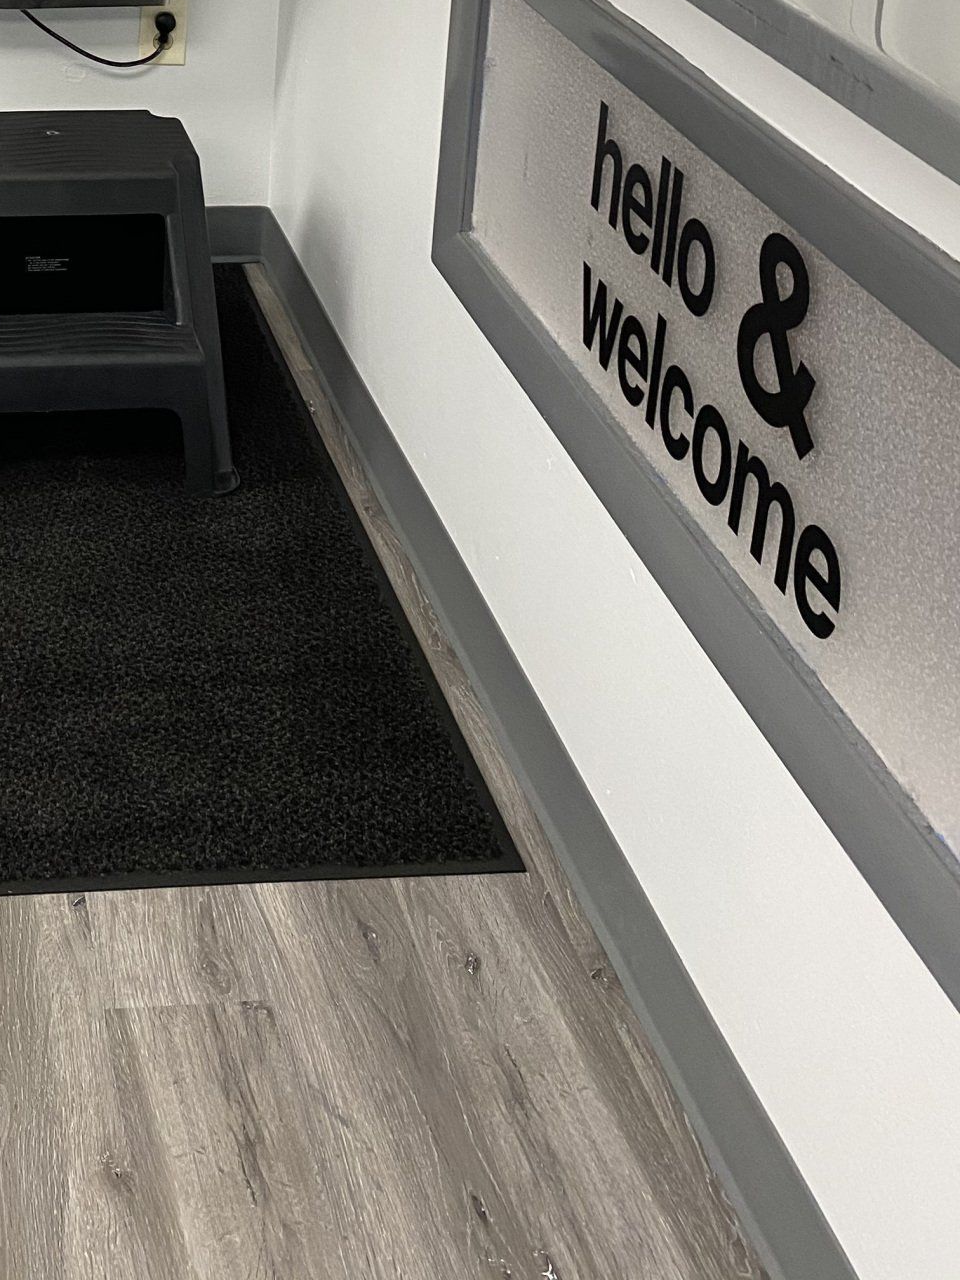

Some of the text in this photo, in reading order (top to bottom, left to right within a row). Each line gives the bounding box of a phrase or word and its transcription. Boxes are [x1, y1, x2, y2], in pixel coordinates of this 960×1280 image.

[582, 260, 842, 640] welcome
[590, 100, 817, 460] hello &
